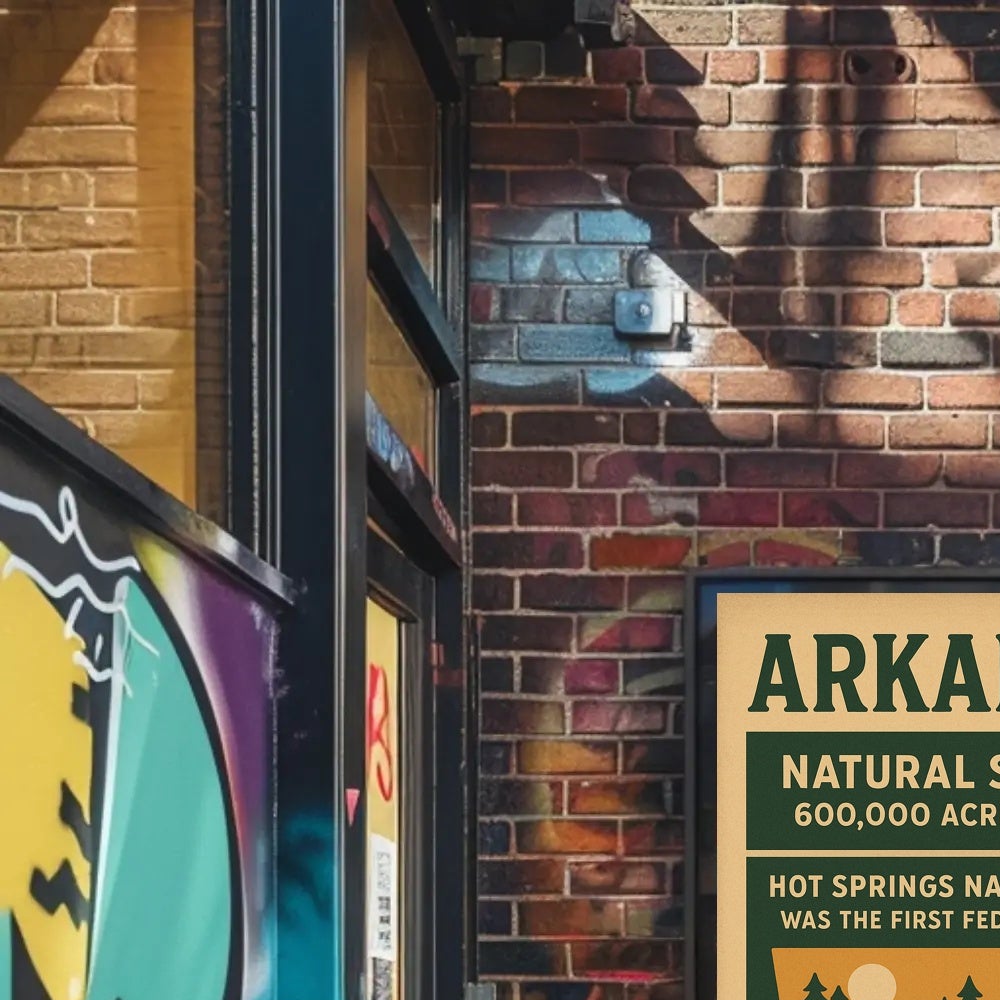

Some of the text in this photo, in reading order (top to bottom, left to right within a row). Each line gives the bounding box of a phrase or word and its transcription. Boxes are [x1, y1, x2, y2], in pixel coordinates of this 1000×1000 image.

[782, 754, 975, 790] NATURAL
[794, 801, 931, 831] 600,000
[769, 874, 824, 898] HOT
[831, 874, 954, 898] SPRINGS
[780, 910, 831, 930] WAS
[839, 910, 882, 930] THE
[891, 910, 955, 930] FIRST
